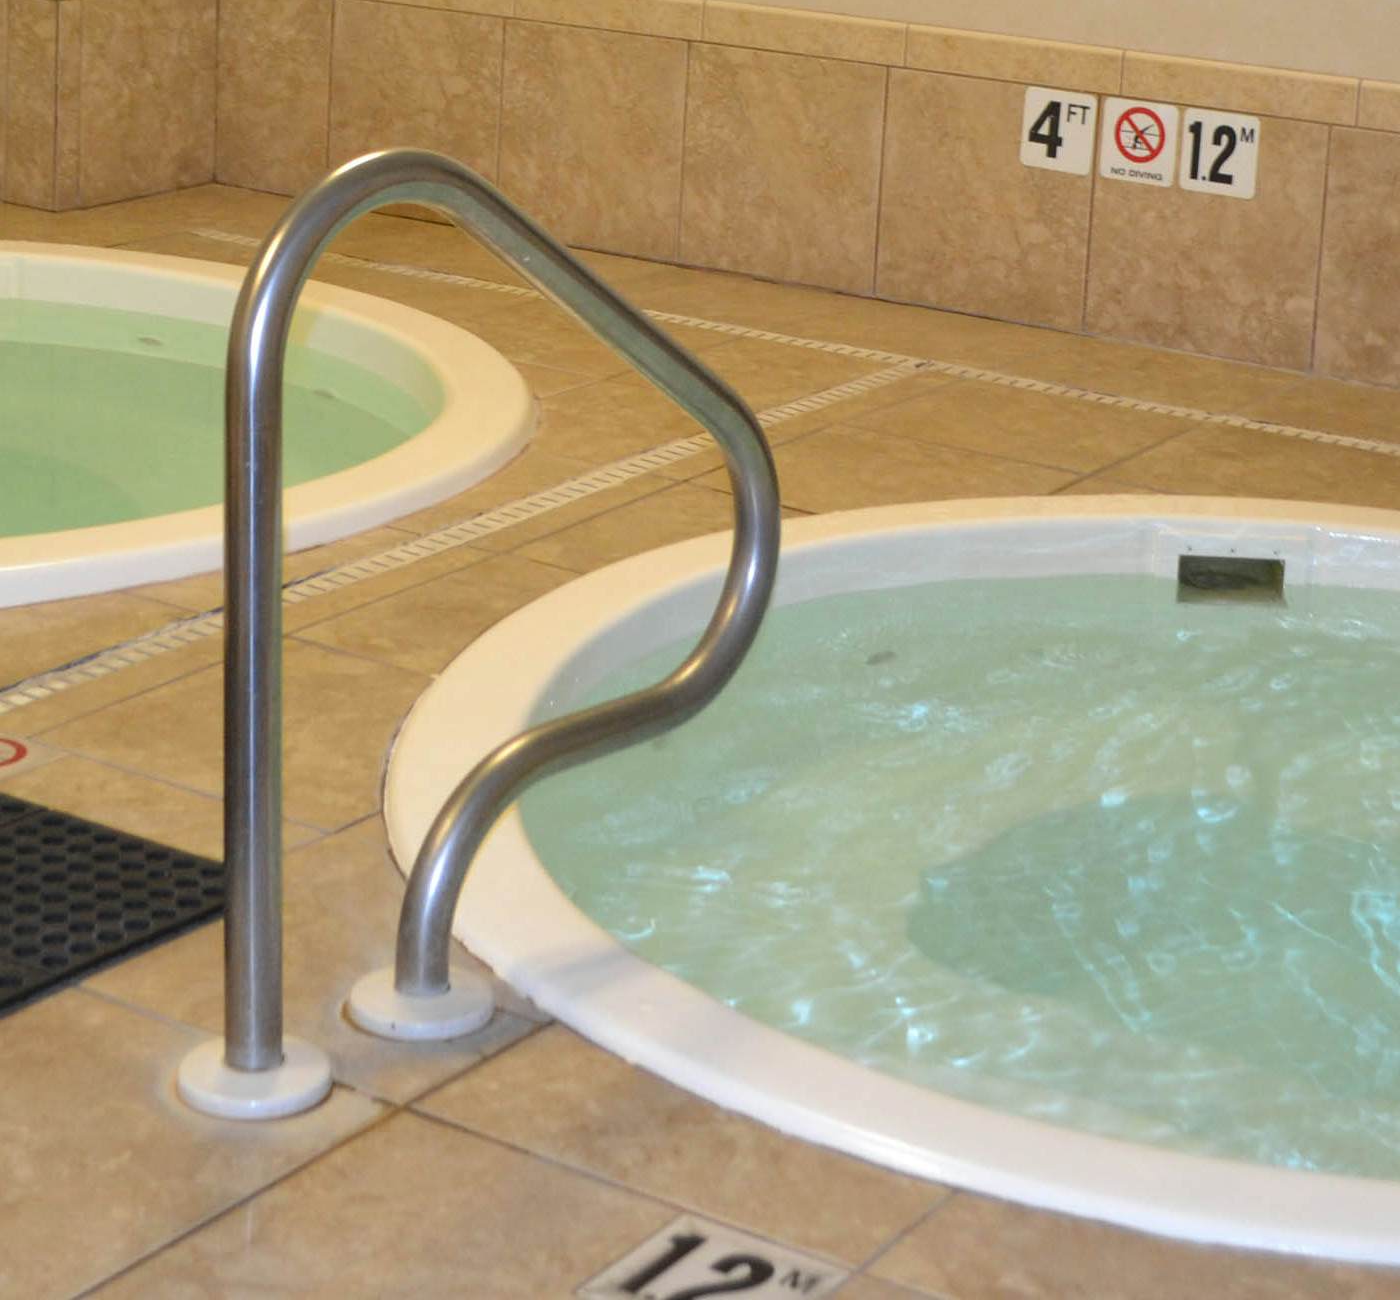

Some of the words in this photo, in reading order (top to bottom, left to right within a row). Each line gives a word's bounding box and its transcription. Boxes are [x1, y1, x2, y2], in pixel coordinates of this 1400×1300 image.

[1028, 100, 1063, 159] 4
[1066, 103, 1091, 126] FT
[1240, 127, 1256, 144] M
[1110, 167, 1126, 176] NO
[1128, 169, 1164, 182] DIVING
[780, 1268, 819, 1294] M
